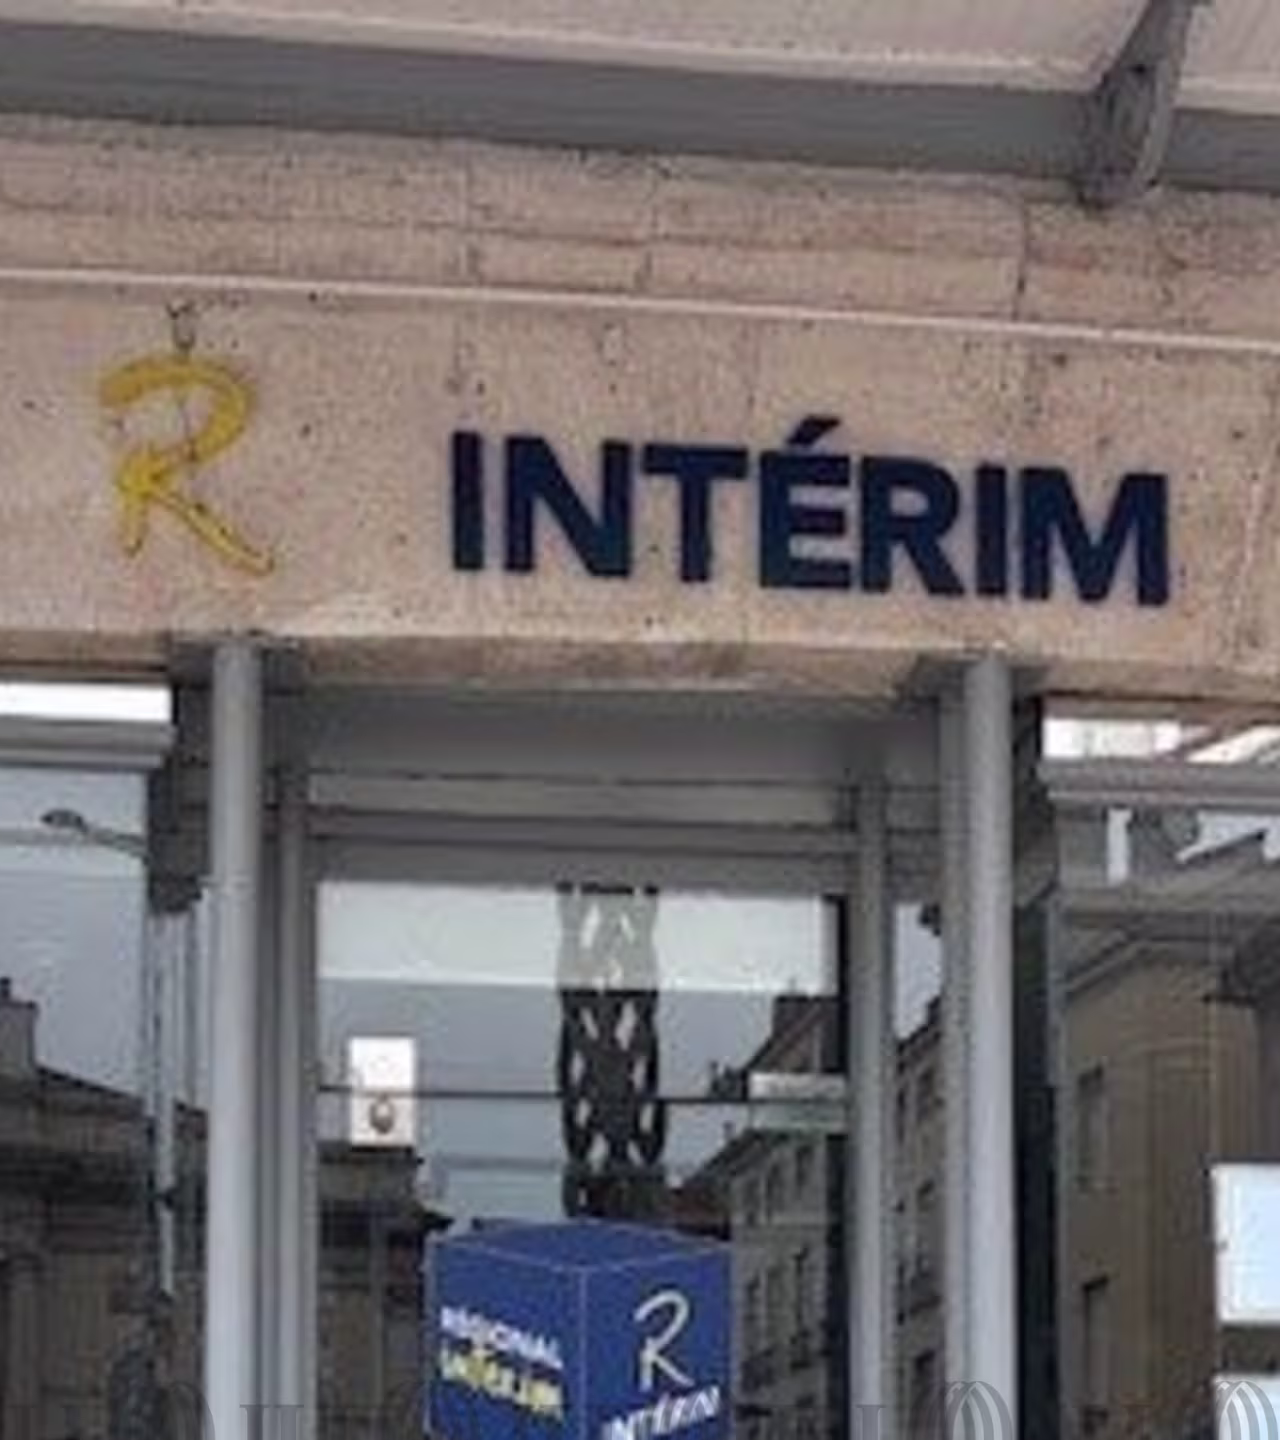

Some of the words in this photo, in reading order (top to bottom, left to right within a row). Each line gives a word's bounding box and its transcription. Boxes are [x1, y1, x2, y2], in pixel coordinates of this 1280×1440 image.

[99, 350, 275, 578] R
[450, 415, 1171, 608] INTÉRIM
[633, 1290, 696, 1393] R
